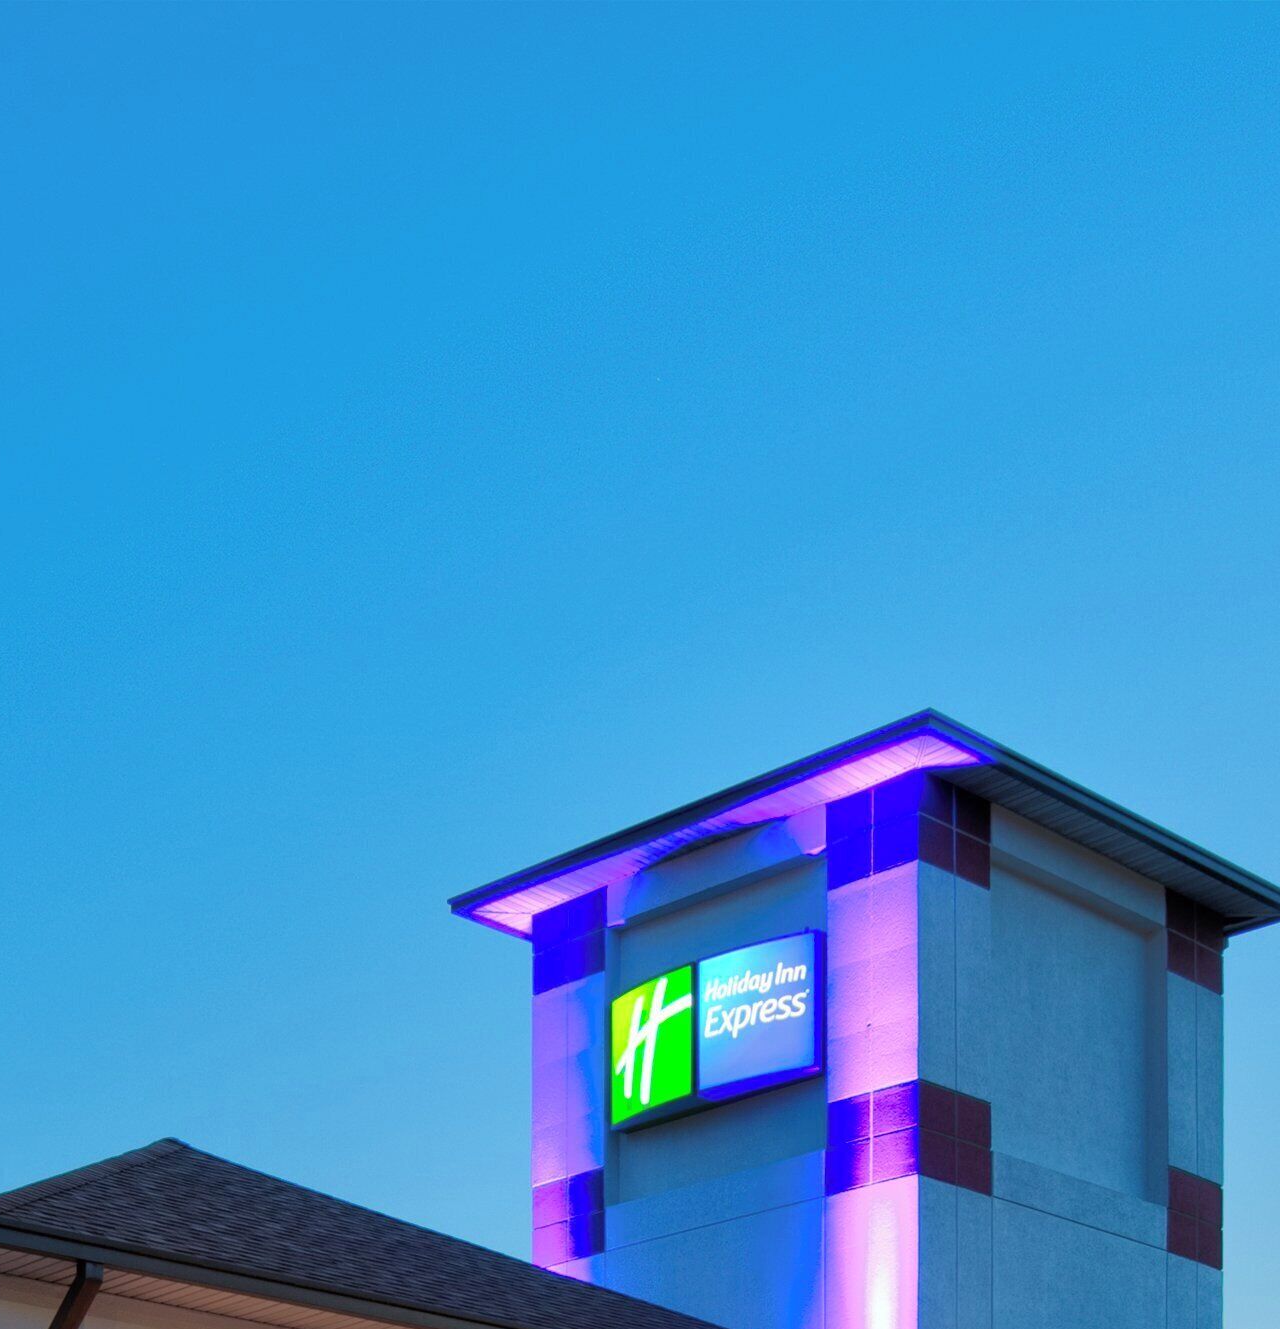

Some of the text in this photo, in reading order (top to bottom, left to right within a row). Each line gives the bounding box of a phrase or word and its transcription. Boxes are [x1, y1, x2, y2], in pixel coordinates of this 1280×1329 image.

[704, 962, 807, 1003] Holiday Inn
[704, 992, 808, 1039] Express
